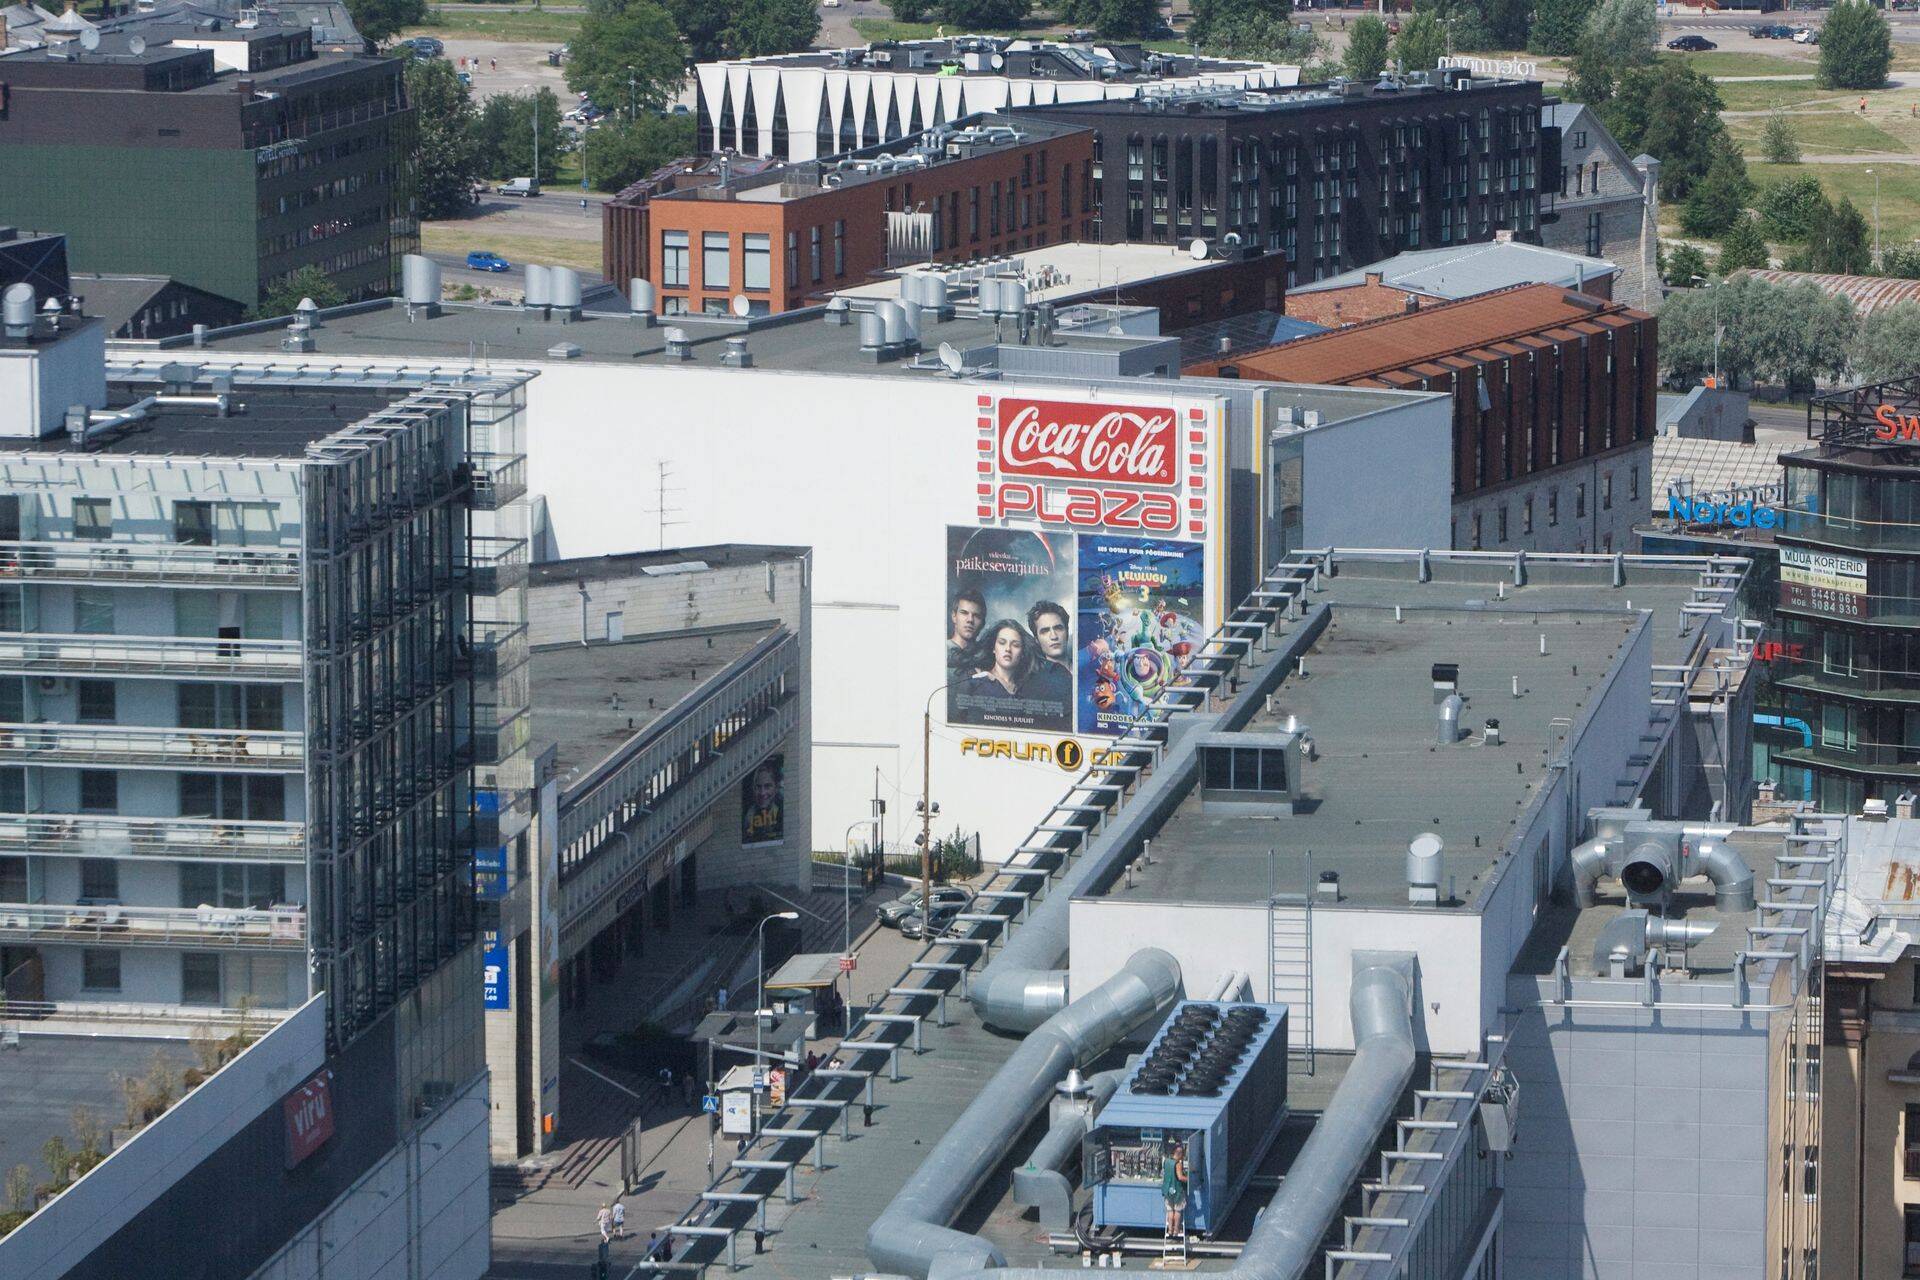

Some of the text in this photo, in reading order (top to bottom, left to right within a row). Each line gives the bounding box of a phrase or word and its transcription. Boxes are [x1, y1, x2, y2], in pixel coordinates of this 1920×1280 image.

[1002, 406, 1172, 477] Coca-Cola
[955, 557, 1049, 578] päikesevarjutus
[1814, 556, 1863, 573] KORTERID
[1118, 570, 1168, 584] LELULUGU
[1138, 584, 1150, 602] 3
[1811, 599, 1836, 612] 5084
[1839, 603, 1858, 616] 930
[960, 737, 1053, 764] FORUM
